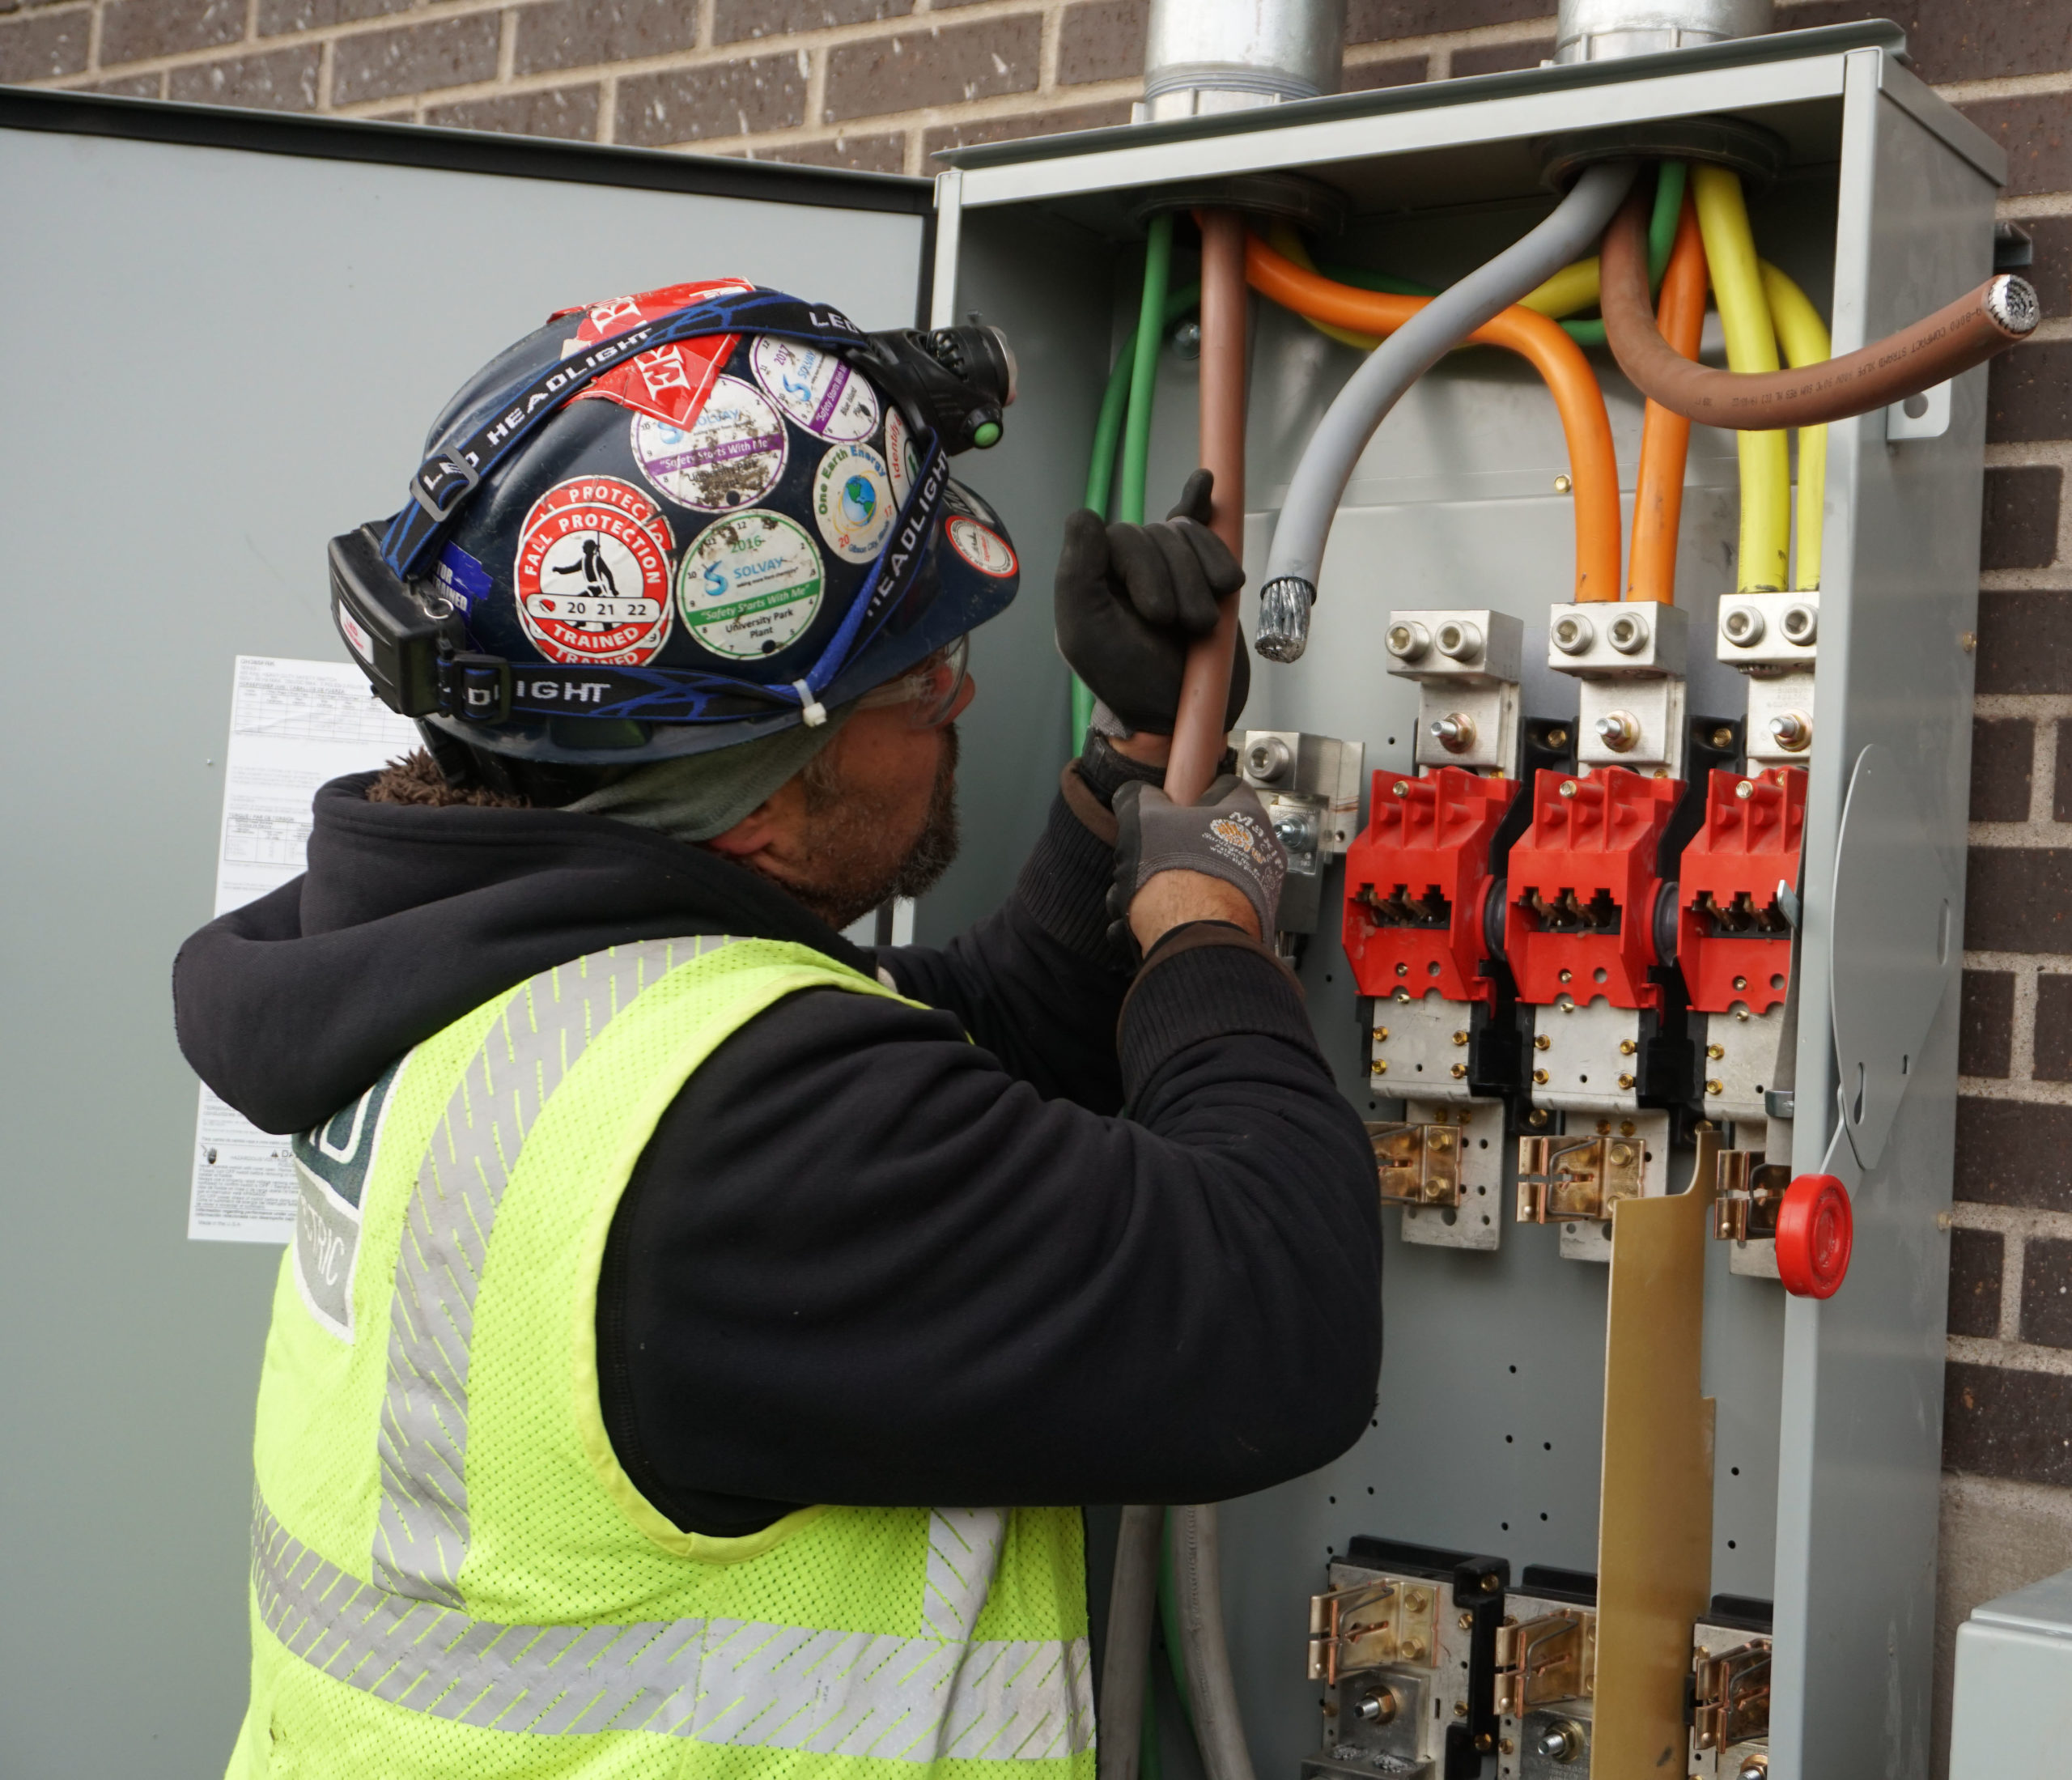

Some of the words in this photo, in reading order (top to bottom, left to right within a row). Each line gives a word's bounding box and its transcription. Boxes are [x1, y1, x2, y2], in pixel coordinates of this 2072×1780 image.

[1911, 326, 1947, 353] COMPACT
[775, 344, 789, 366] 2017
[797, 350, 816, 379] SOLVAY
[1879, 346, 1907, 367] STRAND
[486, 327, 652, 444] HEADLIGHT
[694, 409, 740, 427] OLVAY
[728, 441, 751, 454] With
[891, 422, 901, 479] Identify
[821, 448, 848, 480] Earth
[850, 445, 886, 478] Energy
[819, 483, 828, 515] One
[737, 521, 747, 529] 12
[524, 533, 553, 576] FALL
[558, 513, 661, 584] PROTECTION
[731, 535, 763, 553] 2016
[838, 534, 850, 548] 20
[688, 571, 697, 579] 10
[733, 557, 783, 579] SOLVAY
[767, 590, 789, 603] With
[567, 602, 586, 614] 20
[597, 604, 614, 615] 21
[627, 604, 648, 615] 22
[725, 615, 771, 633] University
[773, 609, 793, 621] Park
[554, 624, 639, 648] TRAINED
[749, 627, 773, 638] Plant
